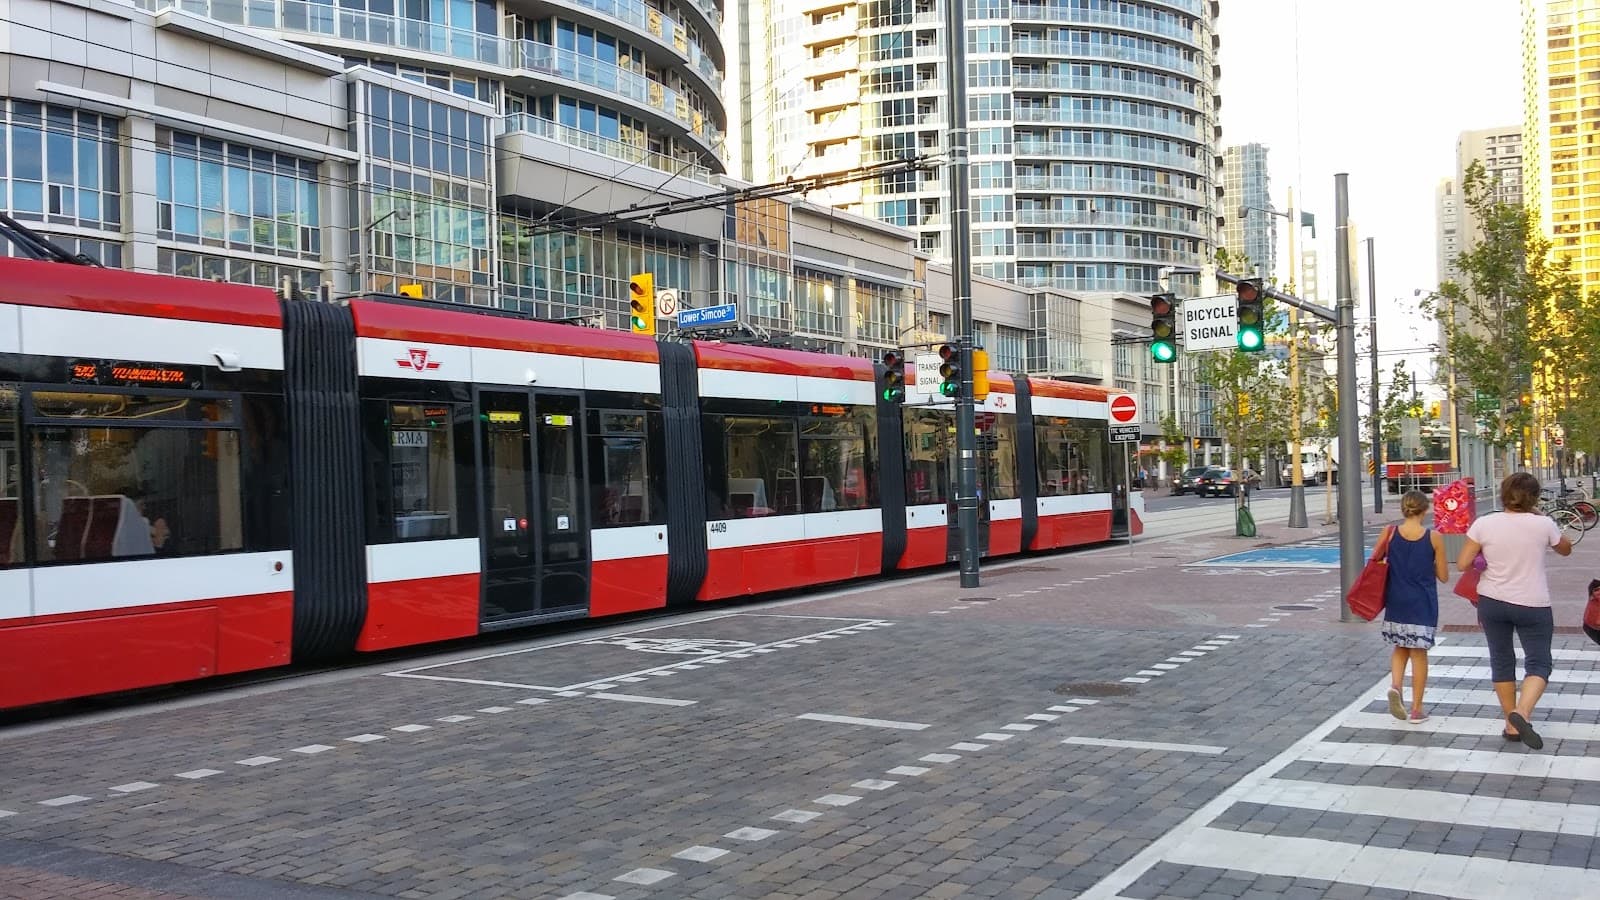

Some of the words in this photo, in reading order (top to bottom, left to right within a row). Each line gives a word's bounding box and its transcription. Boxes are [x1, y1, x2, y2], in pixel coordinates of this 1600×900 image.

[679, 312, 700, 324] Lower
[701, 308, 727, 321] Simcoe
[1186, 305, 1235, 322] BICYCLE
[1190, 325, 1233, 340] SIGNAL
[919, 377, 941, 386] SIGNAL
[1119, 426, 1140, 434] VEHICLES
[710, 522, 727, 534] 4409
